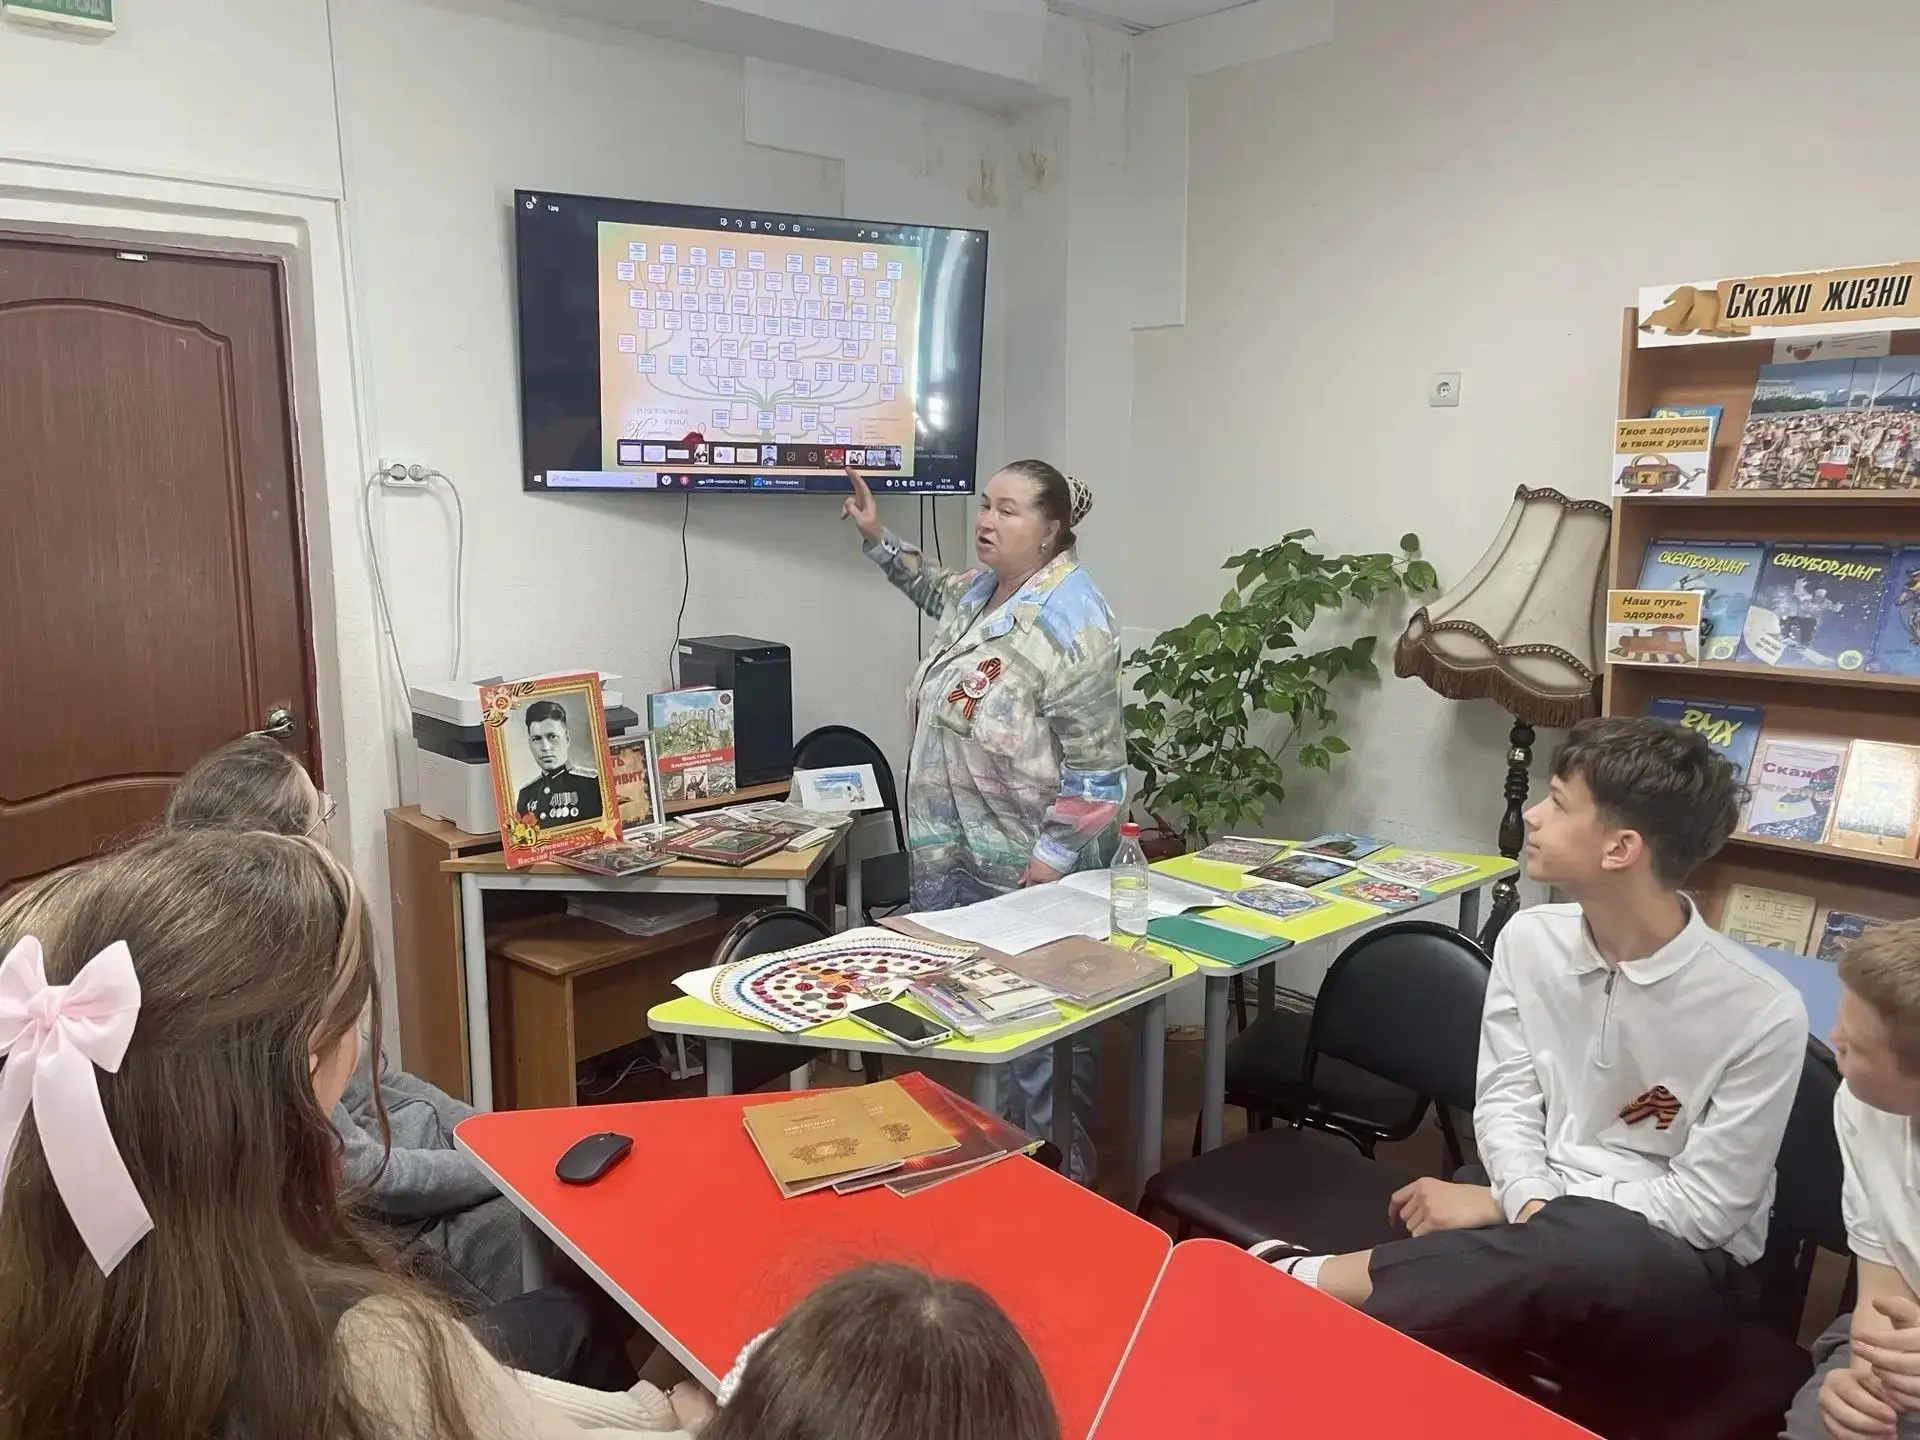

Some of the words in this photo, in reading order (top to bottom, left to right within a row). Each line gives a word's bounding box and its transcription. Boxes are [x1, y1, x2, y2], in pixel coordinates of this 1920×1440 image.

[1725, 283, 1813, 319] Скажи
[1821, 275, 1913, 312] жизни
[1619, 427, 1647, 437] Твое
[1649, 425, 1710, 437] здоровье
[1631, 440, 1664, 448] твоих
[1665, 438, 1705, 449] руках
[1657, 550, 1750, 576] СКЕЙТБОРДИНГ
[1772, 552, 1882, 582] СНОУБОРДИНГ
[1622, 596, 1651, 607] Наш
[1623, 611, 1685, 621] здоровье
